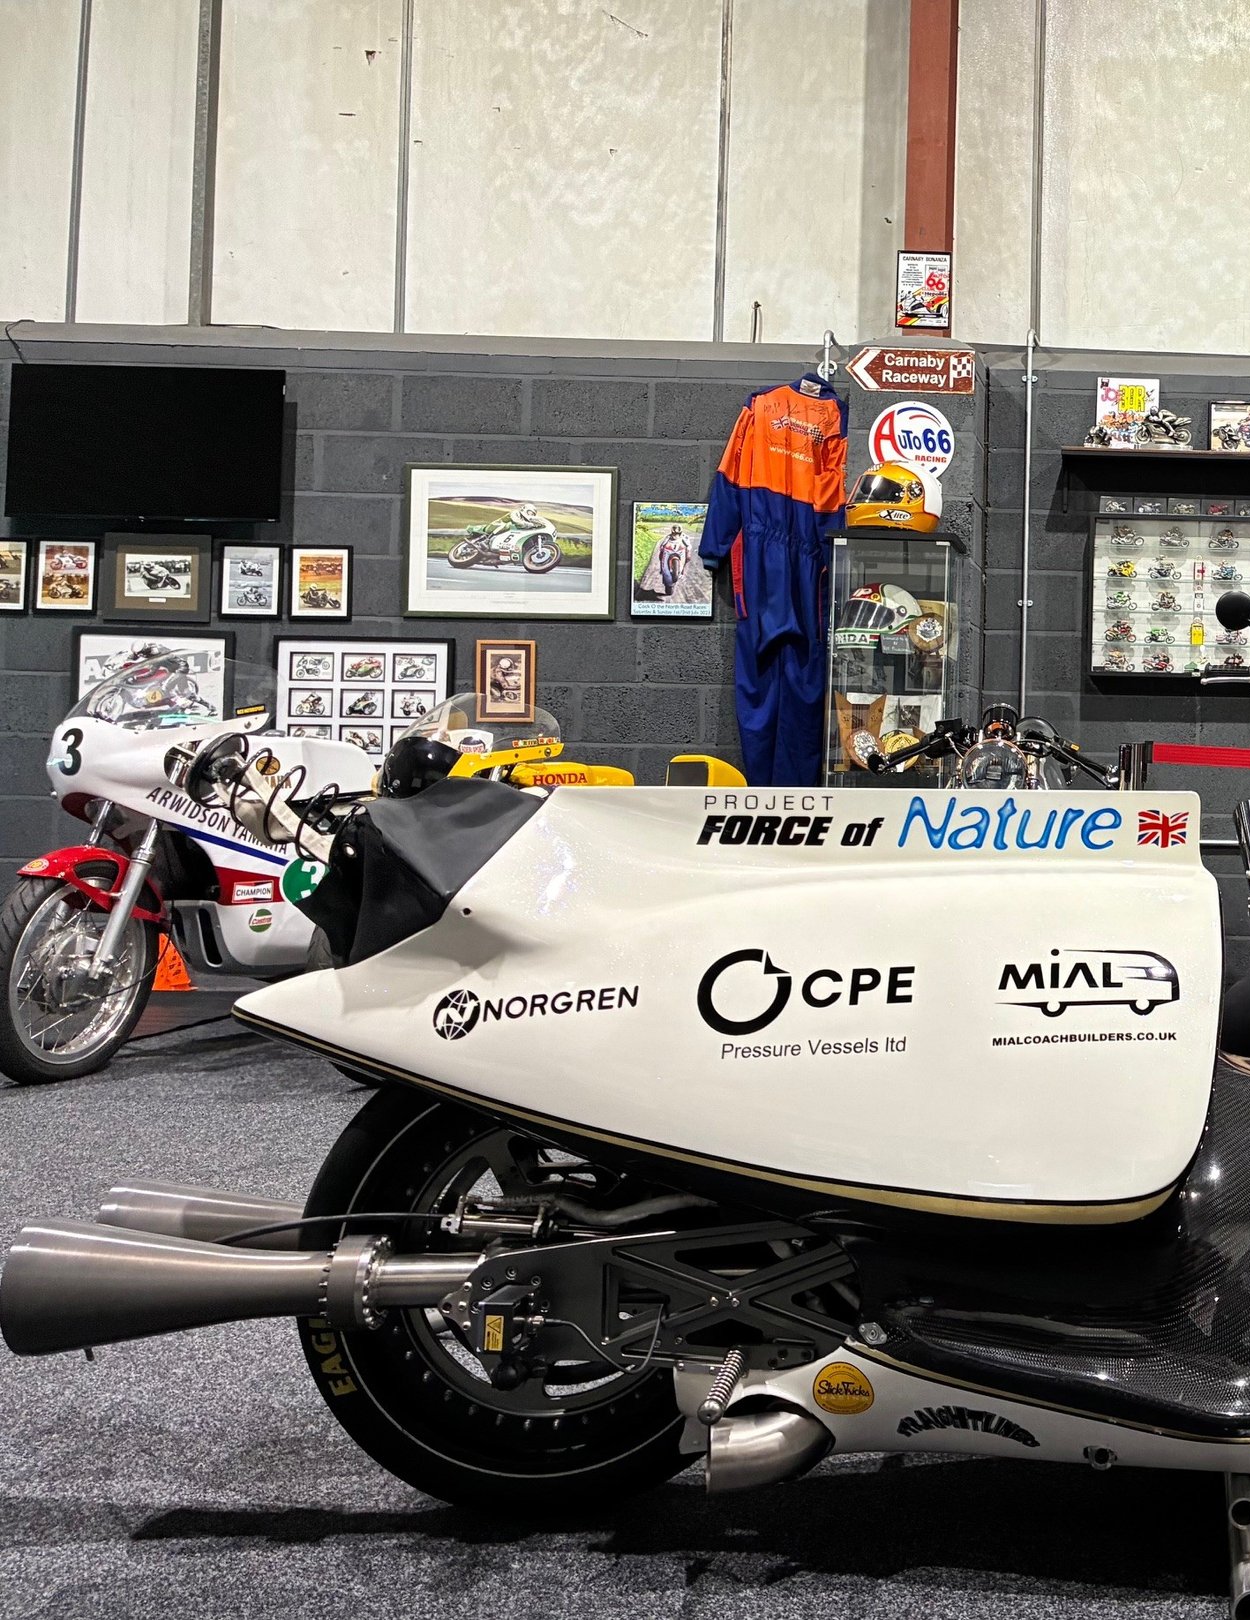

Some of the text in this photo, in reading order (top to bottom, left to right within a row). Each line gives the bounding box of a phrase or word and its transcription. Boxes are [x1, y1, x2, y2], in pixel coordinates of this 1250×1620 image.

[884, 353, 945, 370] Carnaby
[882, 369, 947, 387] Raceway
[914, 455, 947, 463] RACING
[59, 727, 84, 776] 3
[533, 772, 588, 786] HONDA
[146, 787, 230, 833] ARWIDSON
[704, 795, 834, 811] PROJECT
[696, 796, 1122, 850] FORCE of Nature
[236, 887, 271, 897] CHAMPION
[802, 966, 916, 1008] CPE
[482, 985, 640, 1022] NORGREN
[720, 1036, 907, 1060] Pressure Vessels ltd
[992, 1032, 1177, 1046] MIALCOACHBUILDERS.CO.UK
